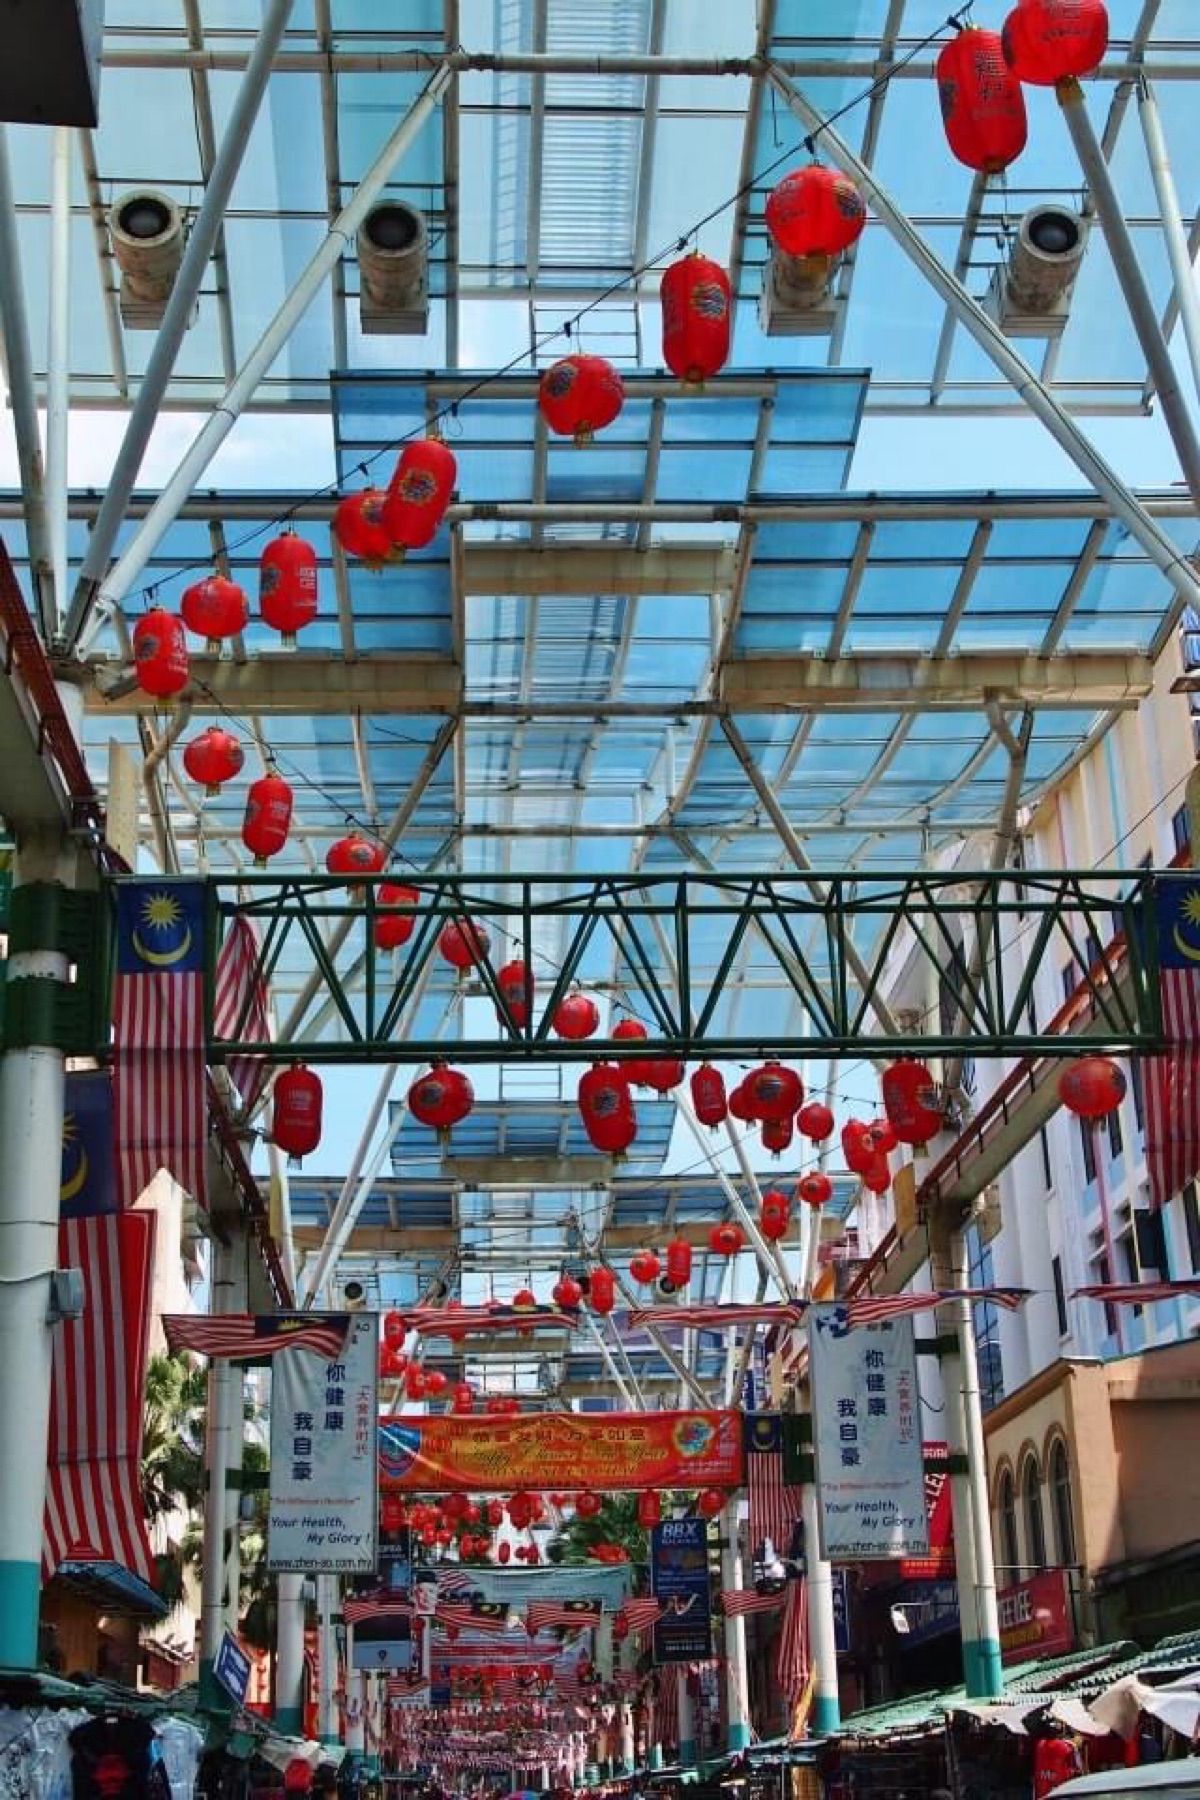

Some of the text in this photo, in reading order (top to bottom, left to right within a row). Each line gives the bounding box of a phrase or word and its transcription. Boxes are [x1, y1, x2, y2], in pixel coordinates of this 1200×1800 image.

[324, 1364, 345, 1432] 你健康
[865, 1349, 888, 1417] 你健康
[292, 1412, 313, 1481] 我自豪
[837, 1398, 862, 1467] 我自豪
[271, 1515, 346, 1530] Your Health,
[306, 1531, 325, 1546] My
